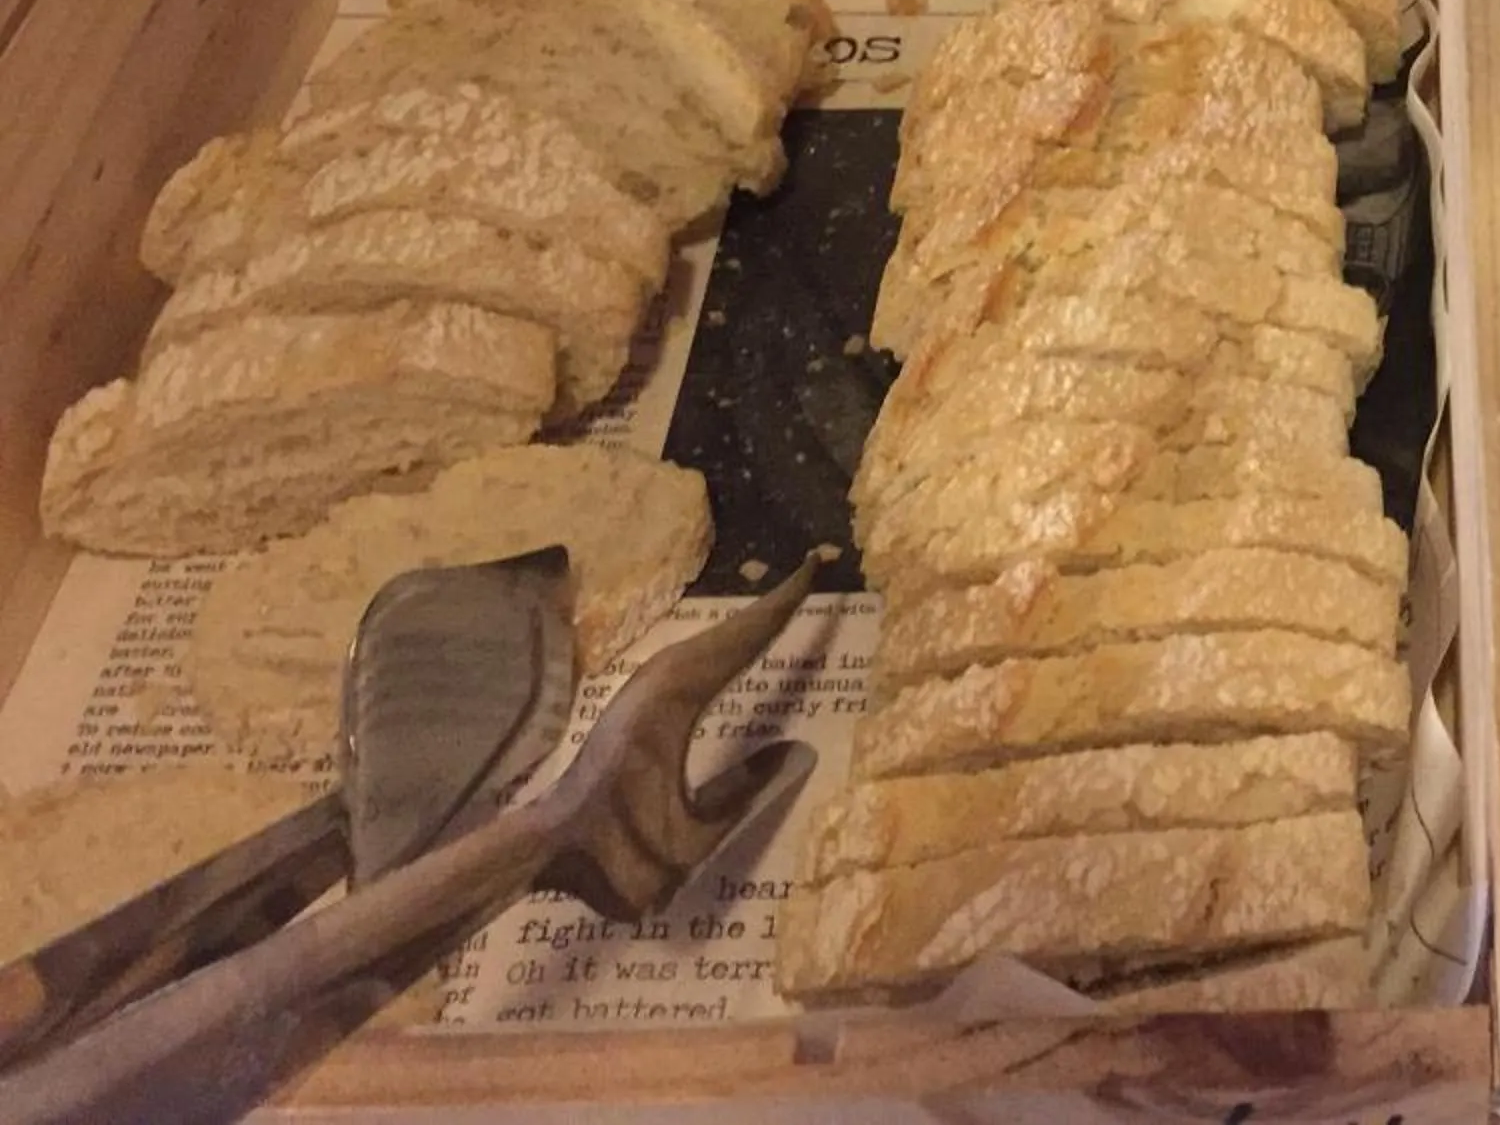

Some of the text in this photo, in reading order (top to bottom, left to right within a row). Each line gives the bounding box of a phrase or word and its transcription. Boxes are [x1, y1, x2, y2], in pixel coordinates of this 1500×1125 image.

[516, 916, 614, 950] fight
[689, 914, 746, 941] the
[563, 956, 597, 982] it
[615, 959, 679, 981] was
[693, 956, 772, 982] terr
